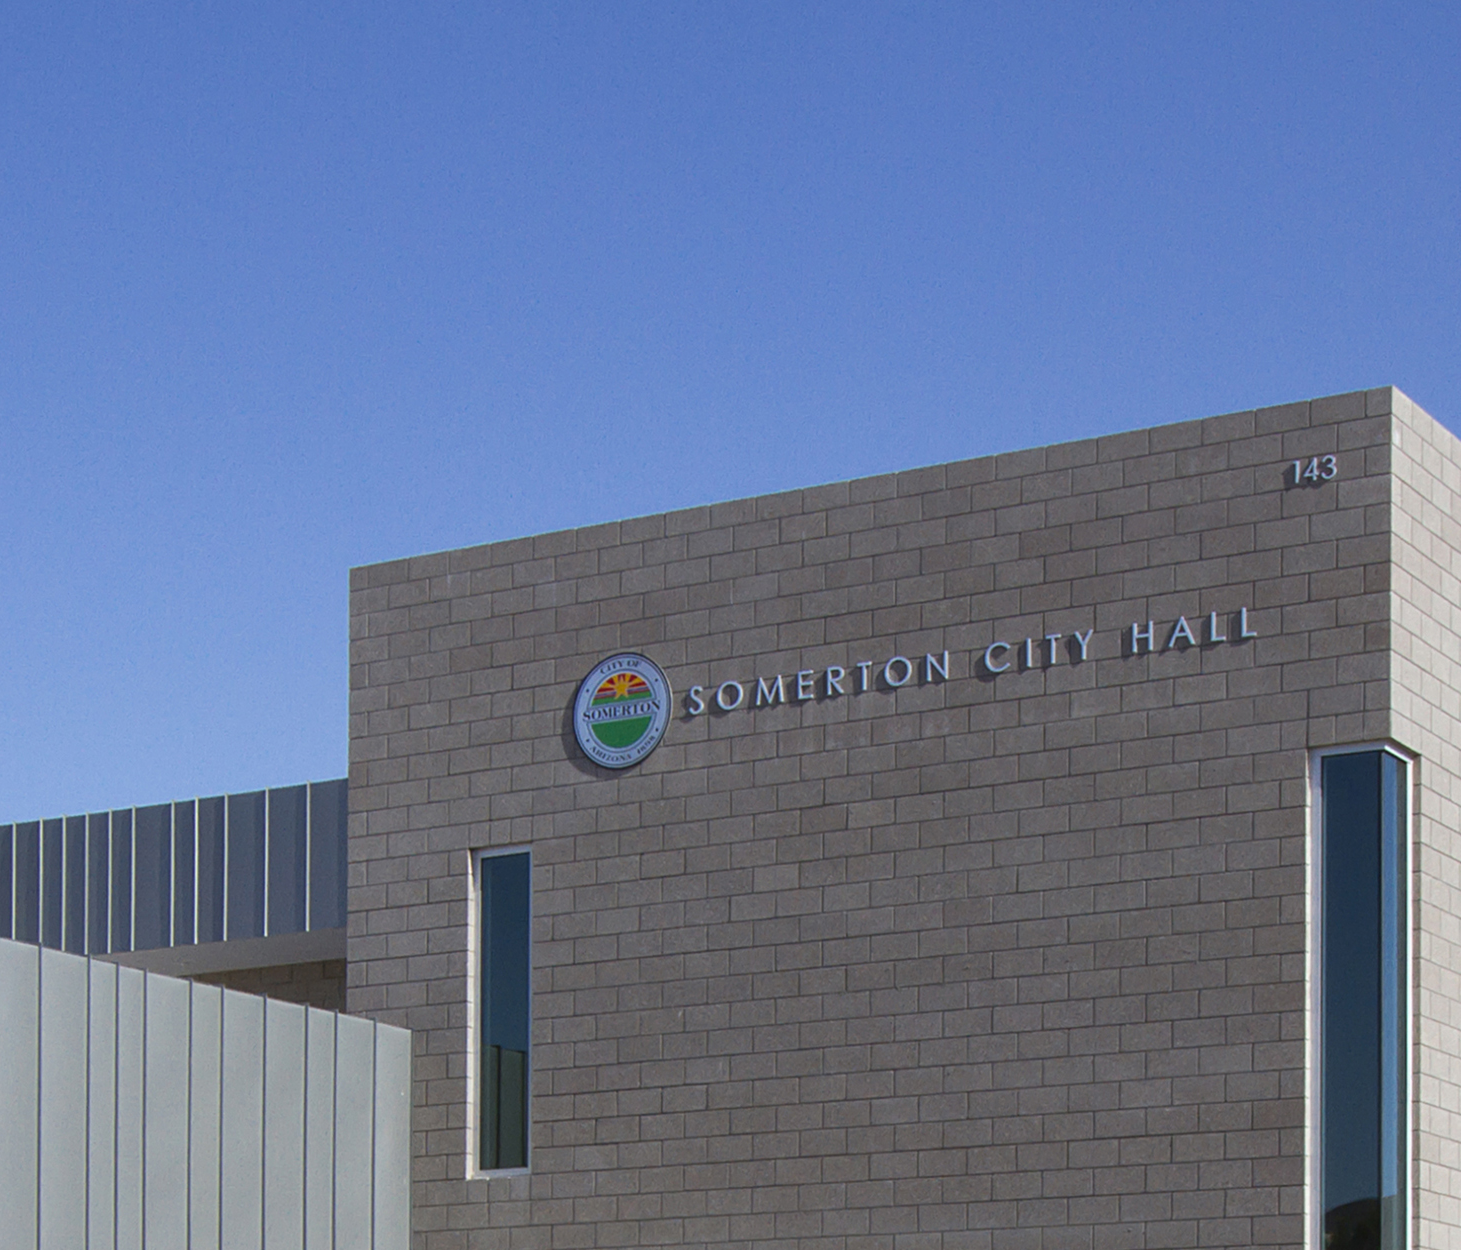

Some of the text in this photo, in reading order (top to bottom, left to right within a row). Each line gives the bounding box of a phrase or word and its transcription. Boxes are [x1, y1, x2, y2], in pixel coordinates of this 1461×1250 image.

[1292, 454, 1338, 484] 143
[600, 661, 624, 675] CITY
[688, 607, 1258, 715] SOMERTON CITY HALL
[583, 700, 660, 722] SOMERTON
[590, 746, 632, 761] ARIZONA
